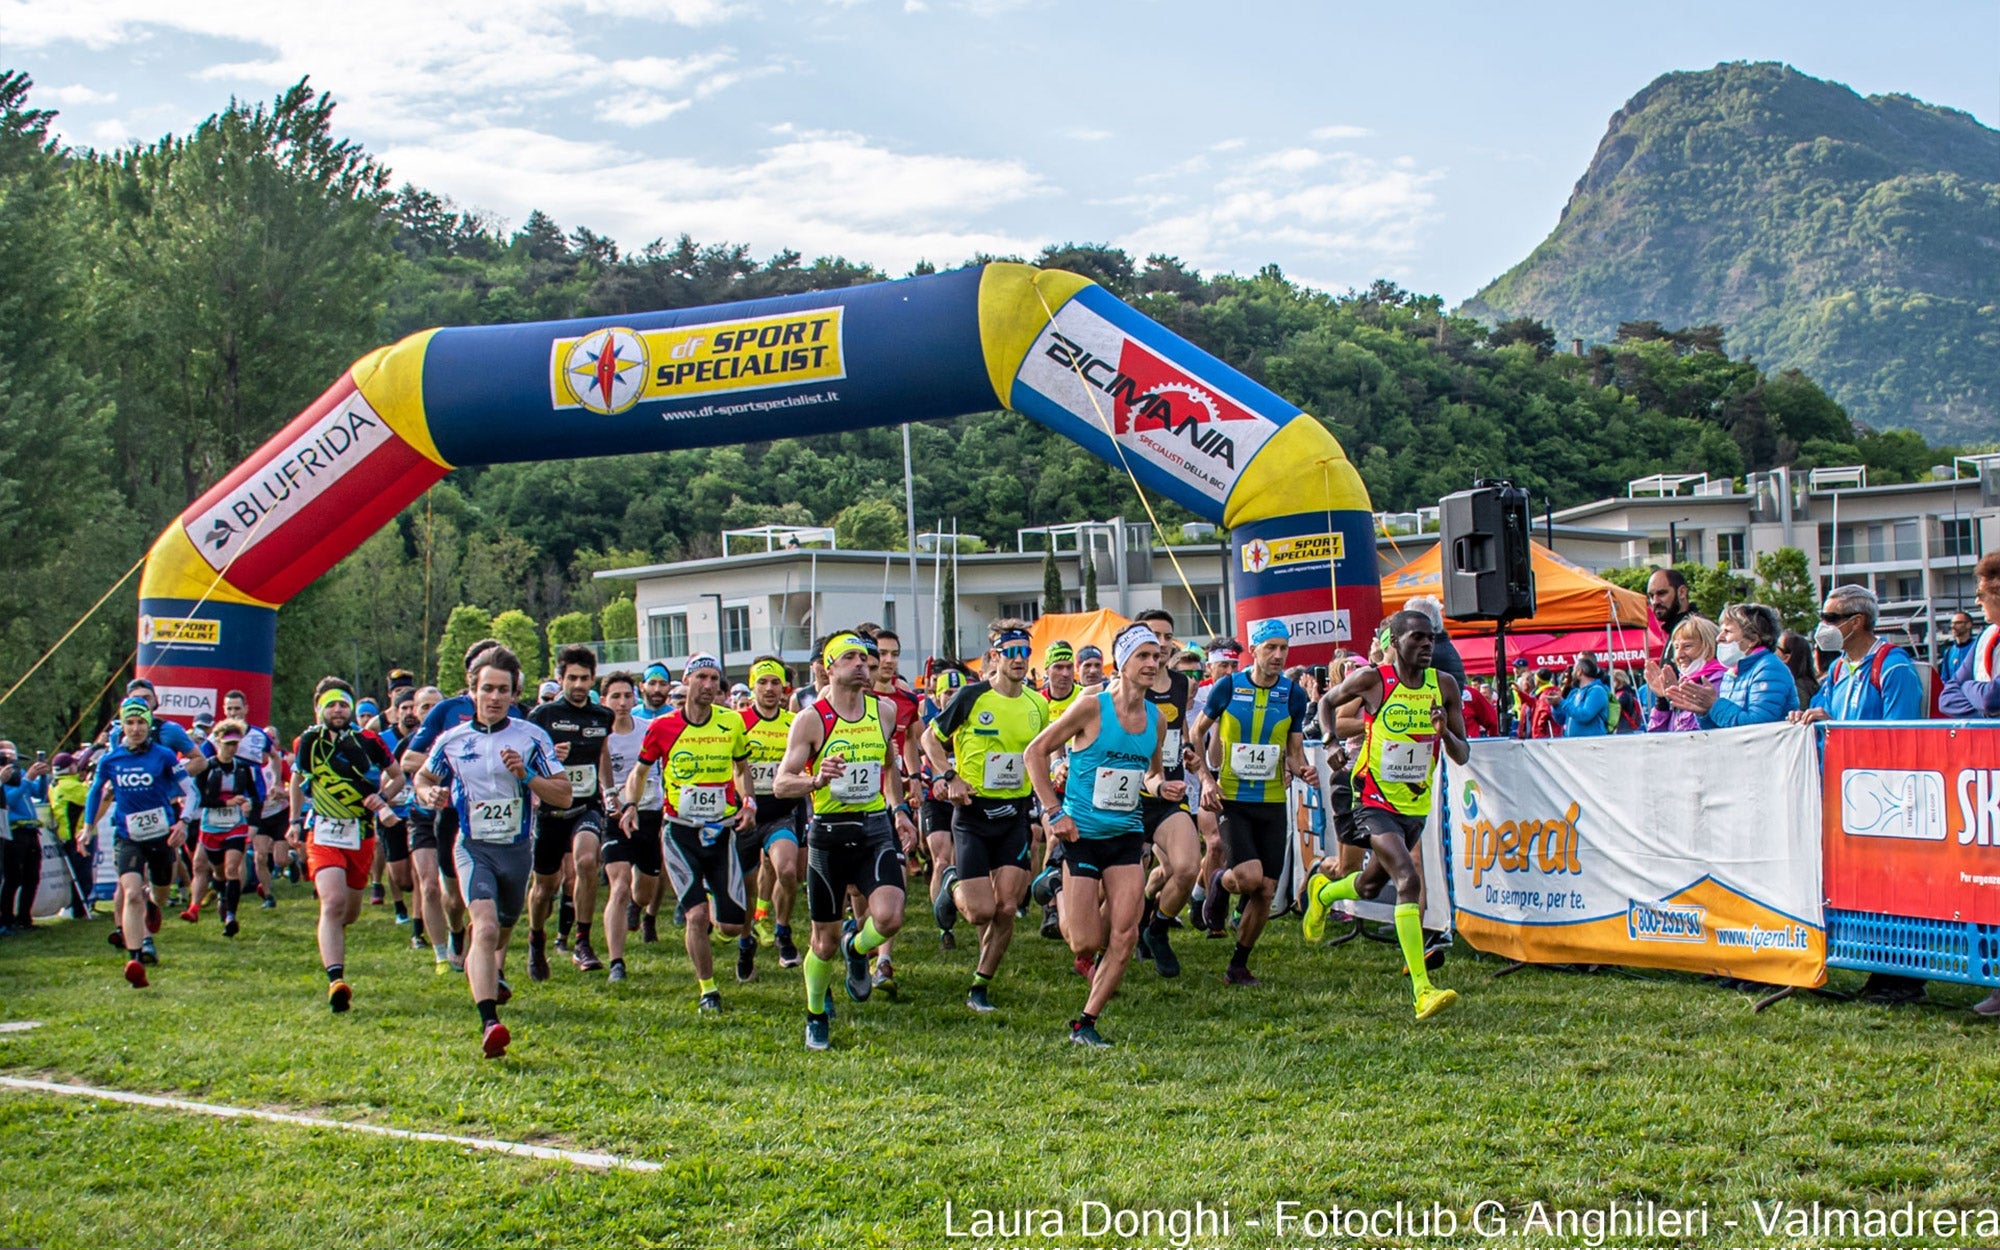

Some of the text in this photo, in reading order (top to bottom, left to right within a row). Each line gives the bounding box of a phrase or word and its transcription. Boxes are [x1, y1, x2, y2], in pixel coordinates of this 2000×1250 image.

[670, 318, 831, 359] df SPORT
[656, 345, 829, 386] SPECIALIST
[661, 391, 841, 421] www.df-sportspecialist.it
[1045, 331, 1235, 471] BICIMANIA
[232, 411, 376, 528] BLUFRIDA
[1138, 434, 1226, 492] SPECIALISTI DELLA BICI
[1294, 536, 1340, 550] SPORT
[1273, 546, 1340, 562] SPECIALIST
[1536, 650, 1646, 666] O.S.A. VMADRERA
[1388, 708, 1418, 716] Corrado
[1392, 720, 1418, 729] Private
[830, 743, 860, 754] Corrado
[1406, 748, 1415, 764] 1
[1249, 750, 1266, 764] 14
[751, 767, 774, 780] 374
[1005, 759, 1014, 772] 4
[1387, 764, 1402, 772] JEAN
[850, 768, 869, 785] 12
[1119, 776, 1129, 791] 2
[691, 792, 716, 805] 164
[483, 803, 512, 819] 224
[137, 813, 159, 827] 236
[1461, 800, 1582, 889] iperal
[1485, 884, 1586, 914] Da sempre, per te.
[1716, 925, 1808, 951] www.iperal.it
